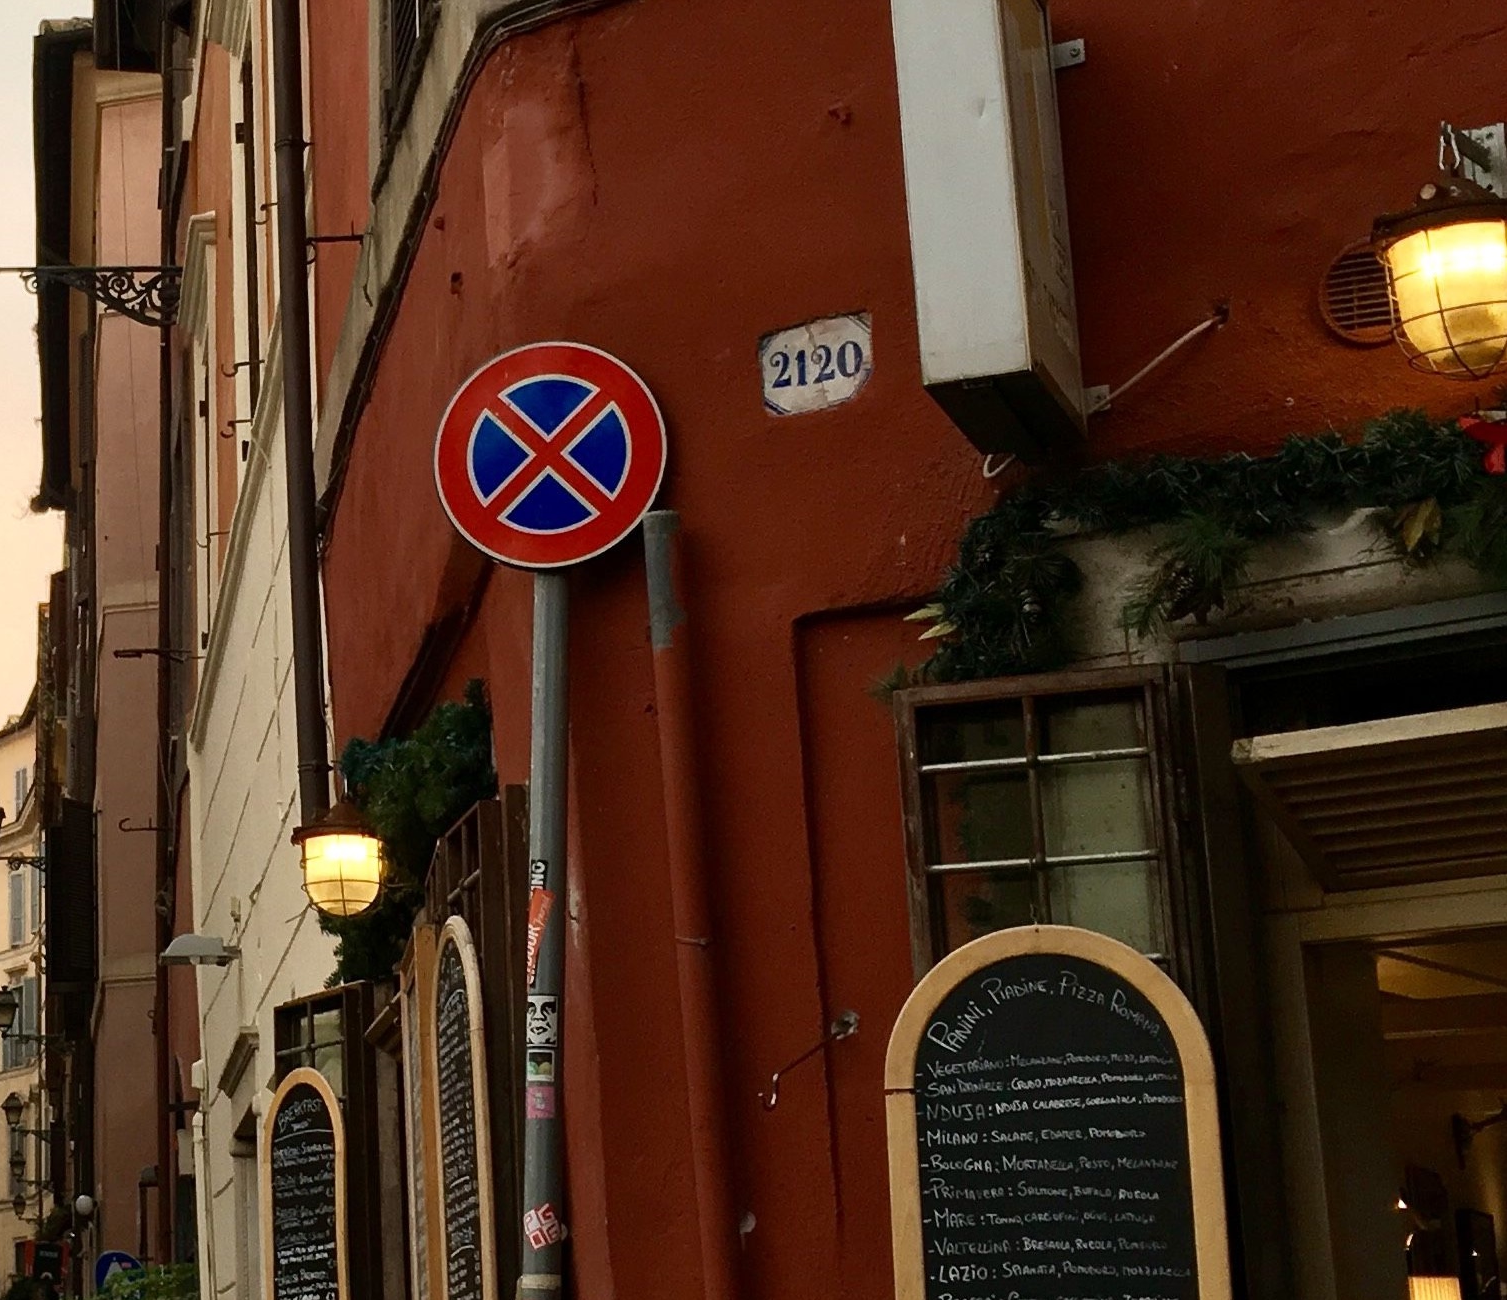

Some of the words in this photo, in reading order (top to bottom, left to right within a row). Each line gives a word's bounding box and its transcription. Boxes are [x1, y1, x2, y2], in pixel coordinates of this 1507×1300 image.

[769, 340, 864, 389] 2120
[1060, 970, 1105, 1005] PIZZA
[924, 1082, 956, 1097] SAN
